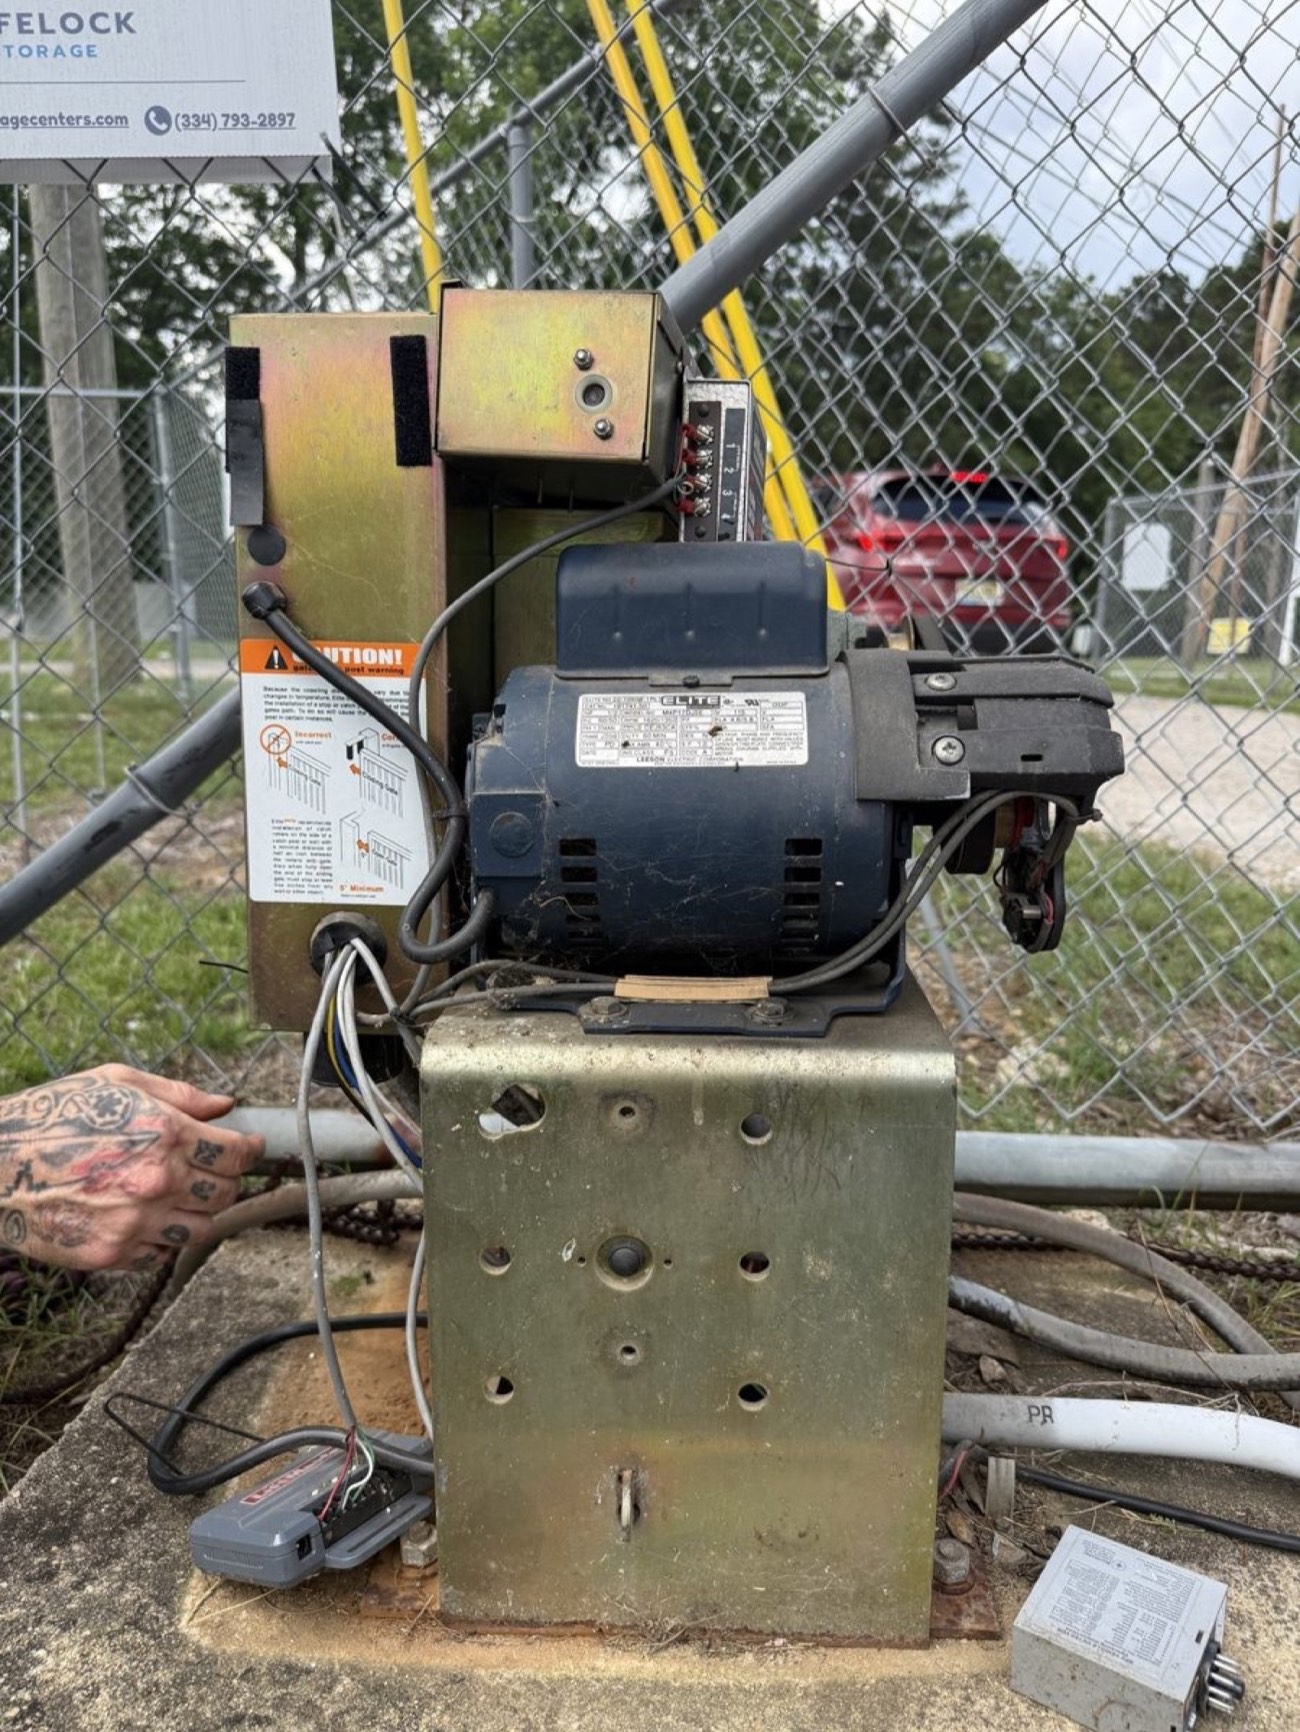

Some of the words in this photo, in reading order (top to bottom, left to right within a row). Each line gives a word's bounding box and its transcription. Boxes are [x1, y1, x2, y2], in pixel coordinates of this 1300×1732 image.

[0, 12, 137, 35] FELOCK
[2, 44, 98, 58] TORAGE
[0, 111, 129, 130] agecenters.com
[175, 112, 218, 132] (334)
[220, 112, 296, 128] 793-2897
[291, 647, 403, 666] UTION!
[368, 667, 404, 675] warning
[661, 696, 719, 705] ELITE
